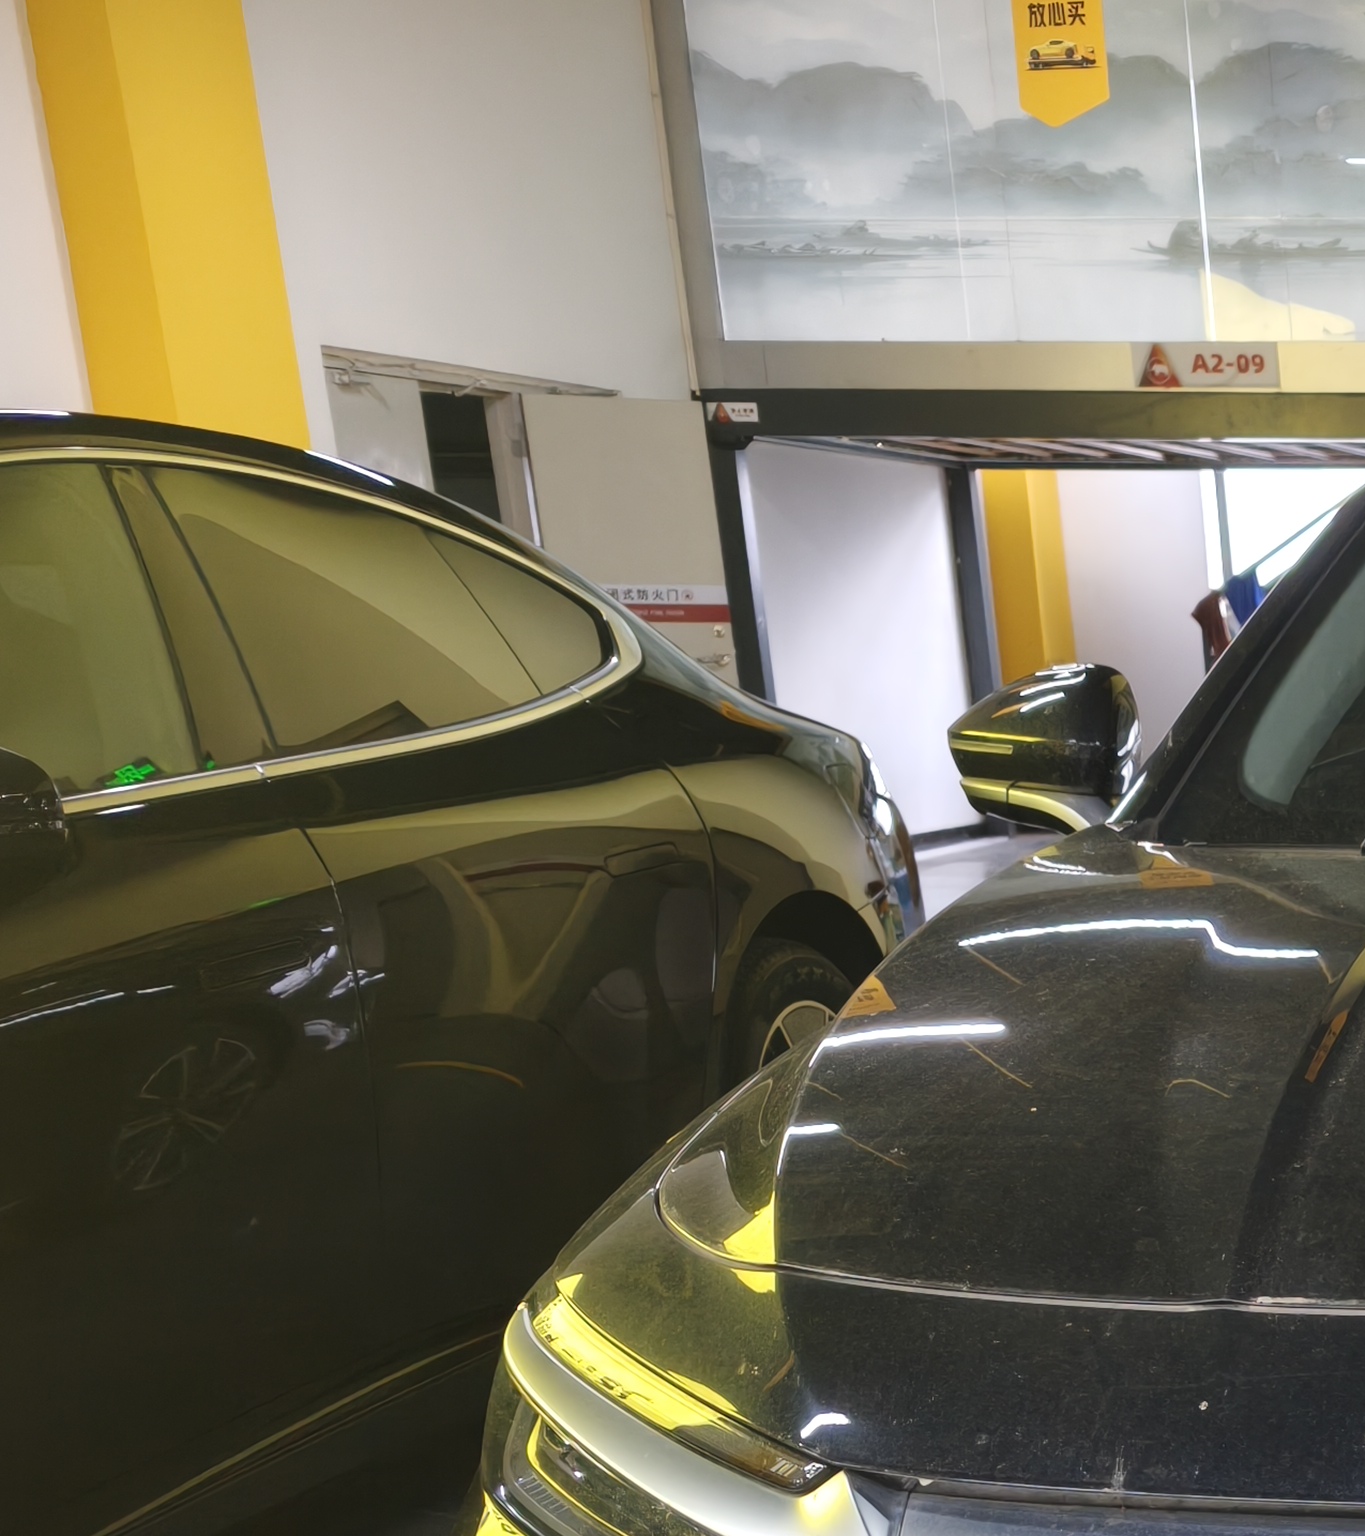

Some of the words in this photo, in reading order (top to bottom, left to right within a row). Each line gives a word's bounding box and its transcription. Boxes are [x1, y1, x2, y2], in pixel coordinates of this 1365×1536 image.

[1027, 1, 1086, 28] 放心买
[1191, 353, 1265, 374] A2-09
